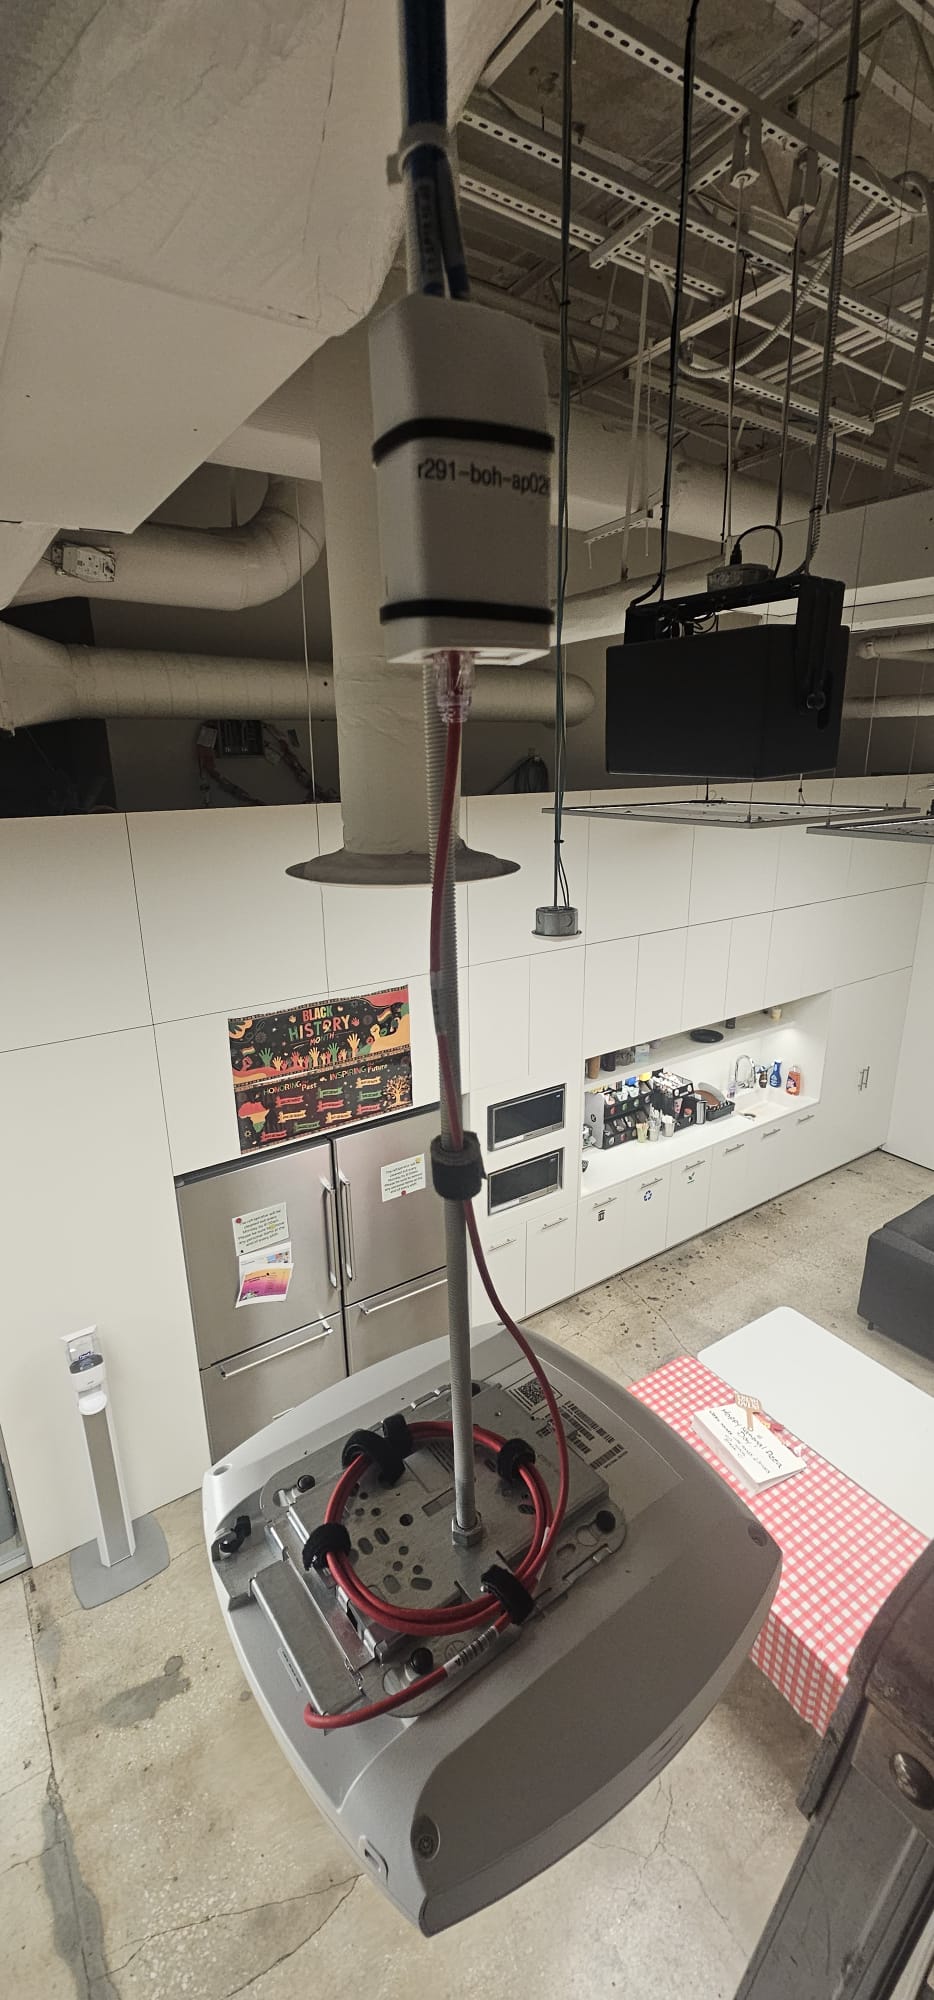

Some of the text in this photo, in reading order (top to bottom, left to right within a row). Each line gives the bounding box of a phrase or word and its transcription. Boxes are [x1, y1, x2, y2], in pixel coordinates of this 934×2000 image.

[302, 1005, 334, 1022] BLACK
[288, 1015, 351, 1042] HISTORY
[309, 1032, 335, 1046] MONTH
[329, 1066, 367, 1081] INSPIRING
[263, 1081, 302, 1096] HONORING
